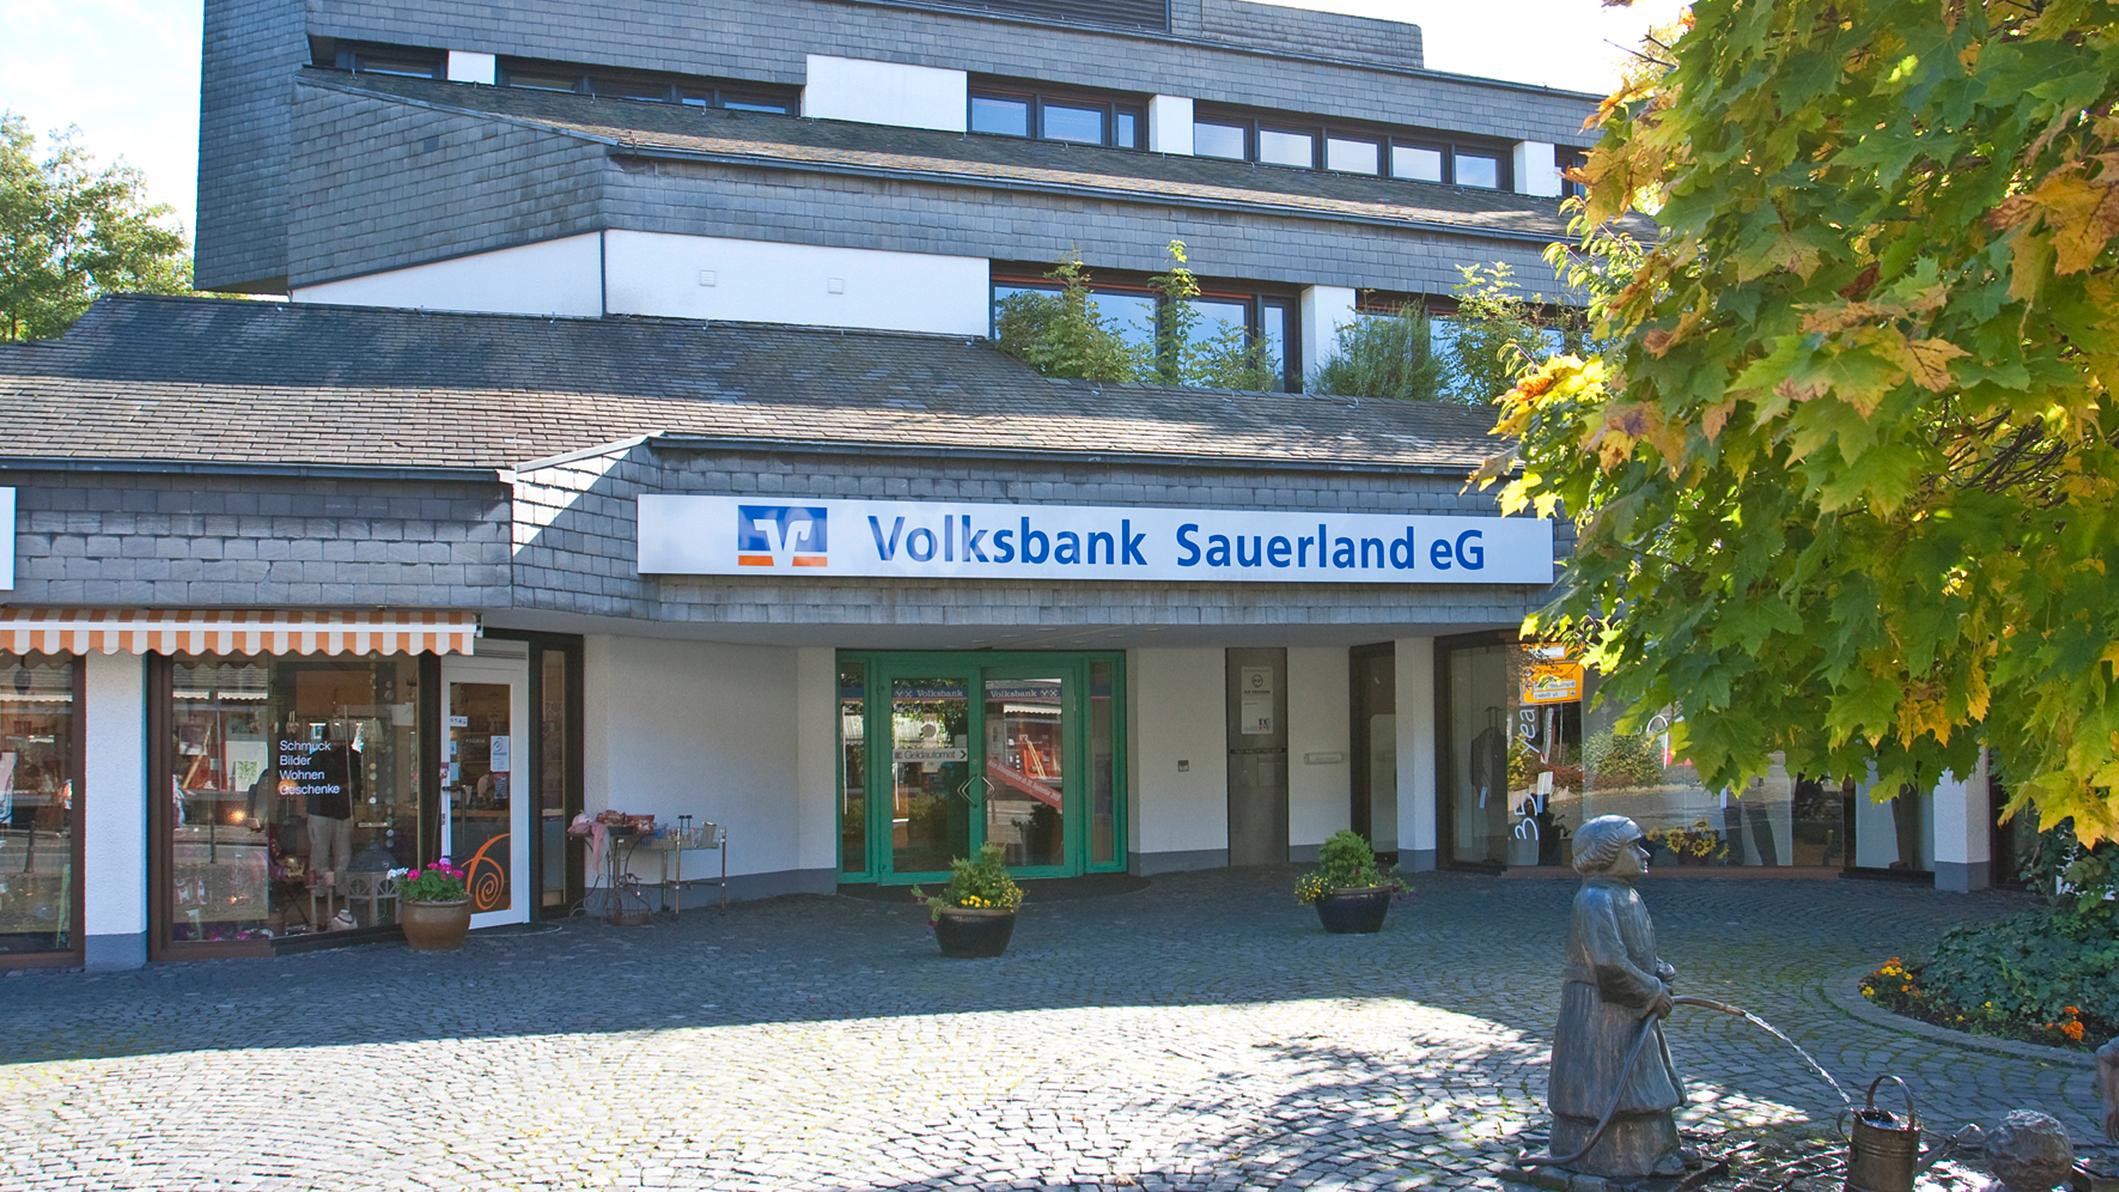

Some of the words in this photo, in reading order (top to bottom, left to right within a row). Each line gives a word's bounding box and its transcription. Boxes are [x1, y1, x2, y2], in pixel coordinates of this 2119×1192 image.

[868, 515, 1147, 566] Volksbank
[1176, 519, 1415, 569] Sauerland
[1430, 529, 1484, 570] eG
[917, 689, 963, 697] Volksbank
[990, 690, 1038, 698] Volksbank
[280, 740, 331, 751] Schmuck
[904, 750, 956, 760] Geldautomat
[280, 755, 312, 766] Bilder
[279, 770, 325, 780] Wohnen
[280, 784, 340, 795] Geschenke
